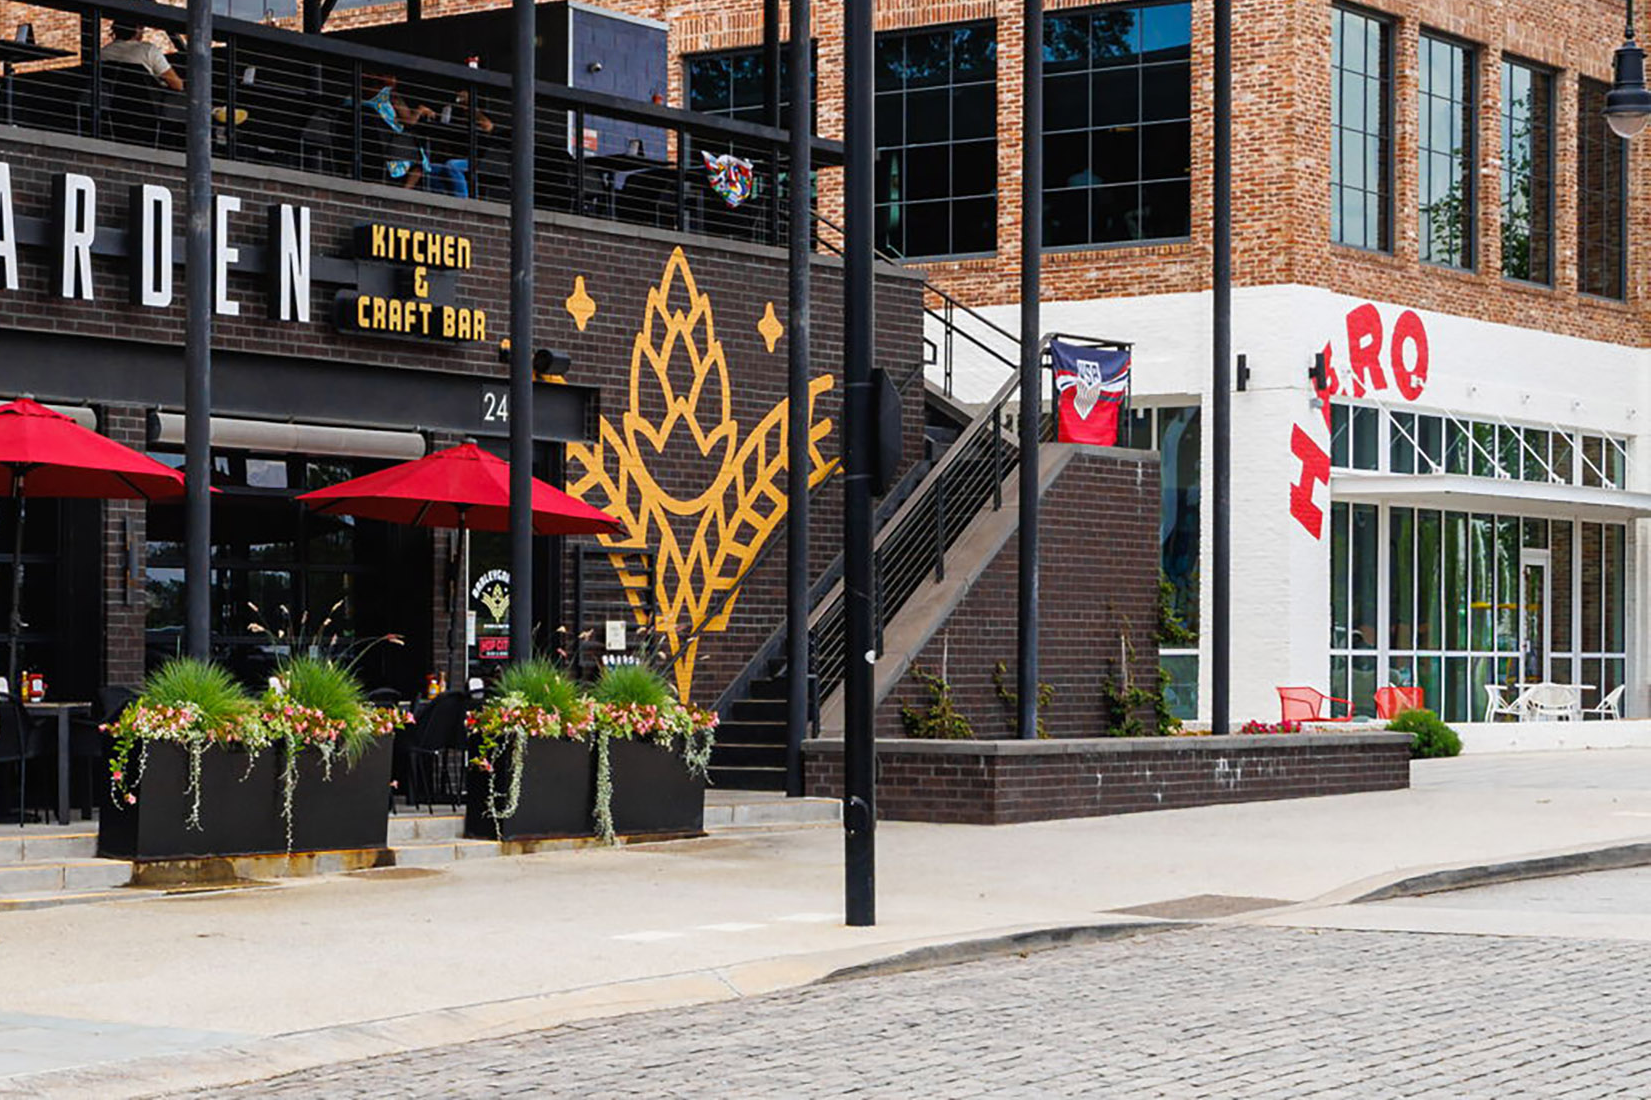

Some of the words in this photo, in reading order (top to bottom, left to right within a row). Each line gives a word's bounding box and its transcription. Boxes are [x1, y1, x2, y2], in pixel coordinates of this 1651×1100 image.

[372, 224, 471, 269] KITCHEN
[414, 266, 429, 298] &
[357, 296, 432, 335] CRAFT
[443, 305, 486, 341] BAR
